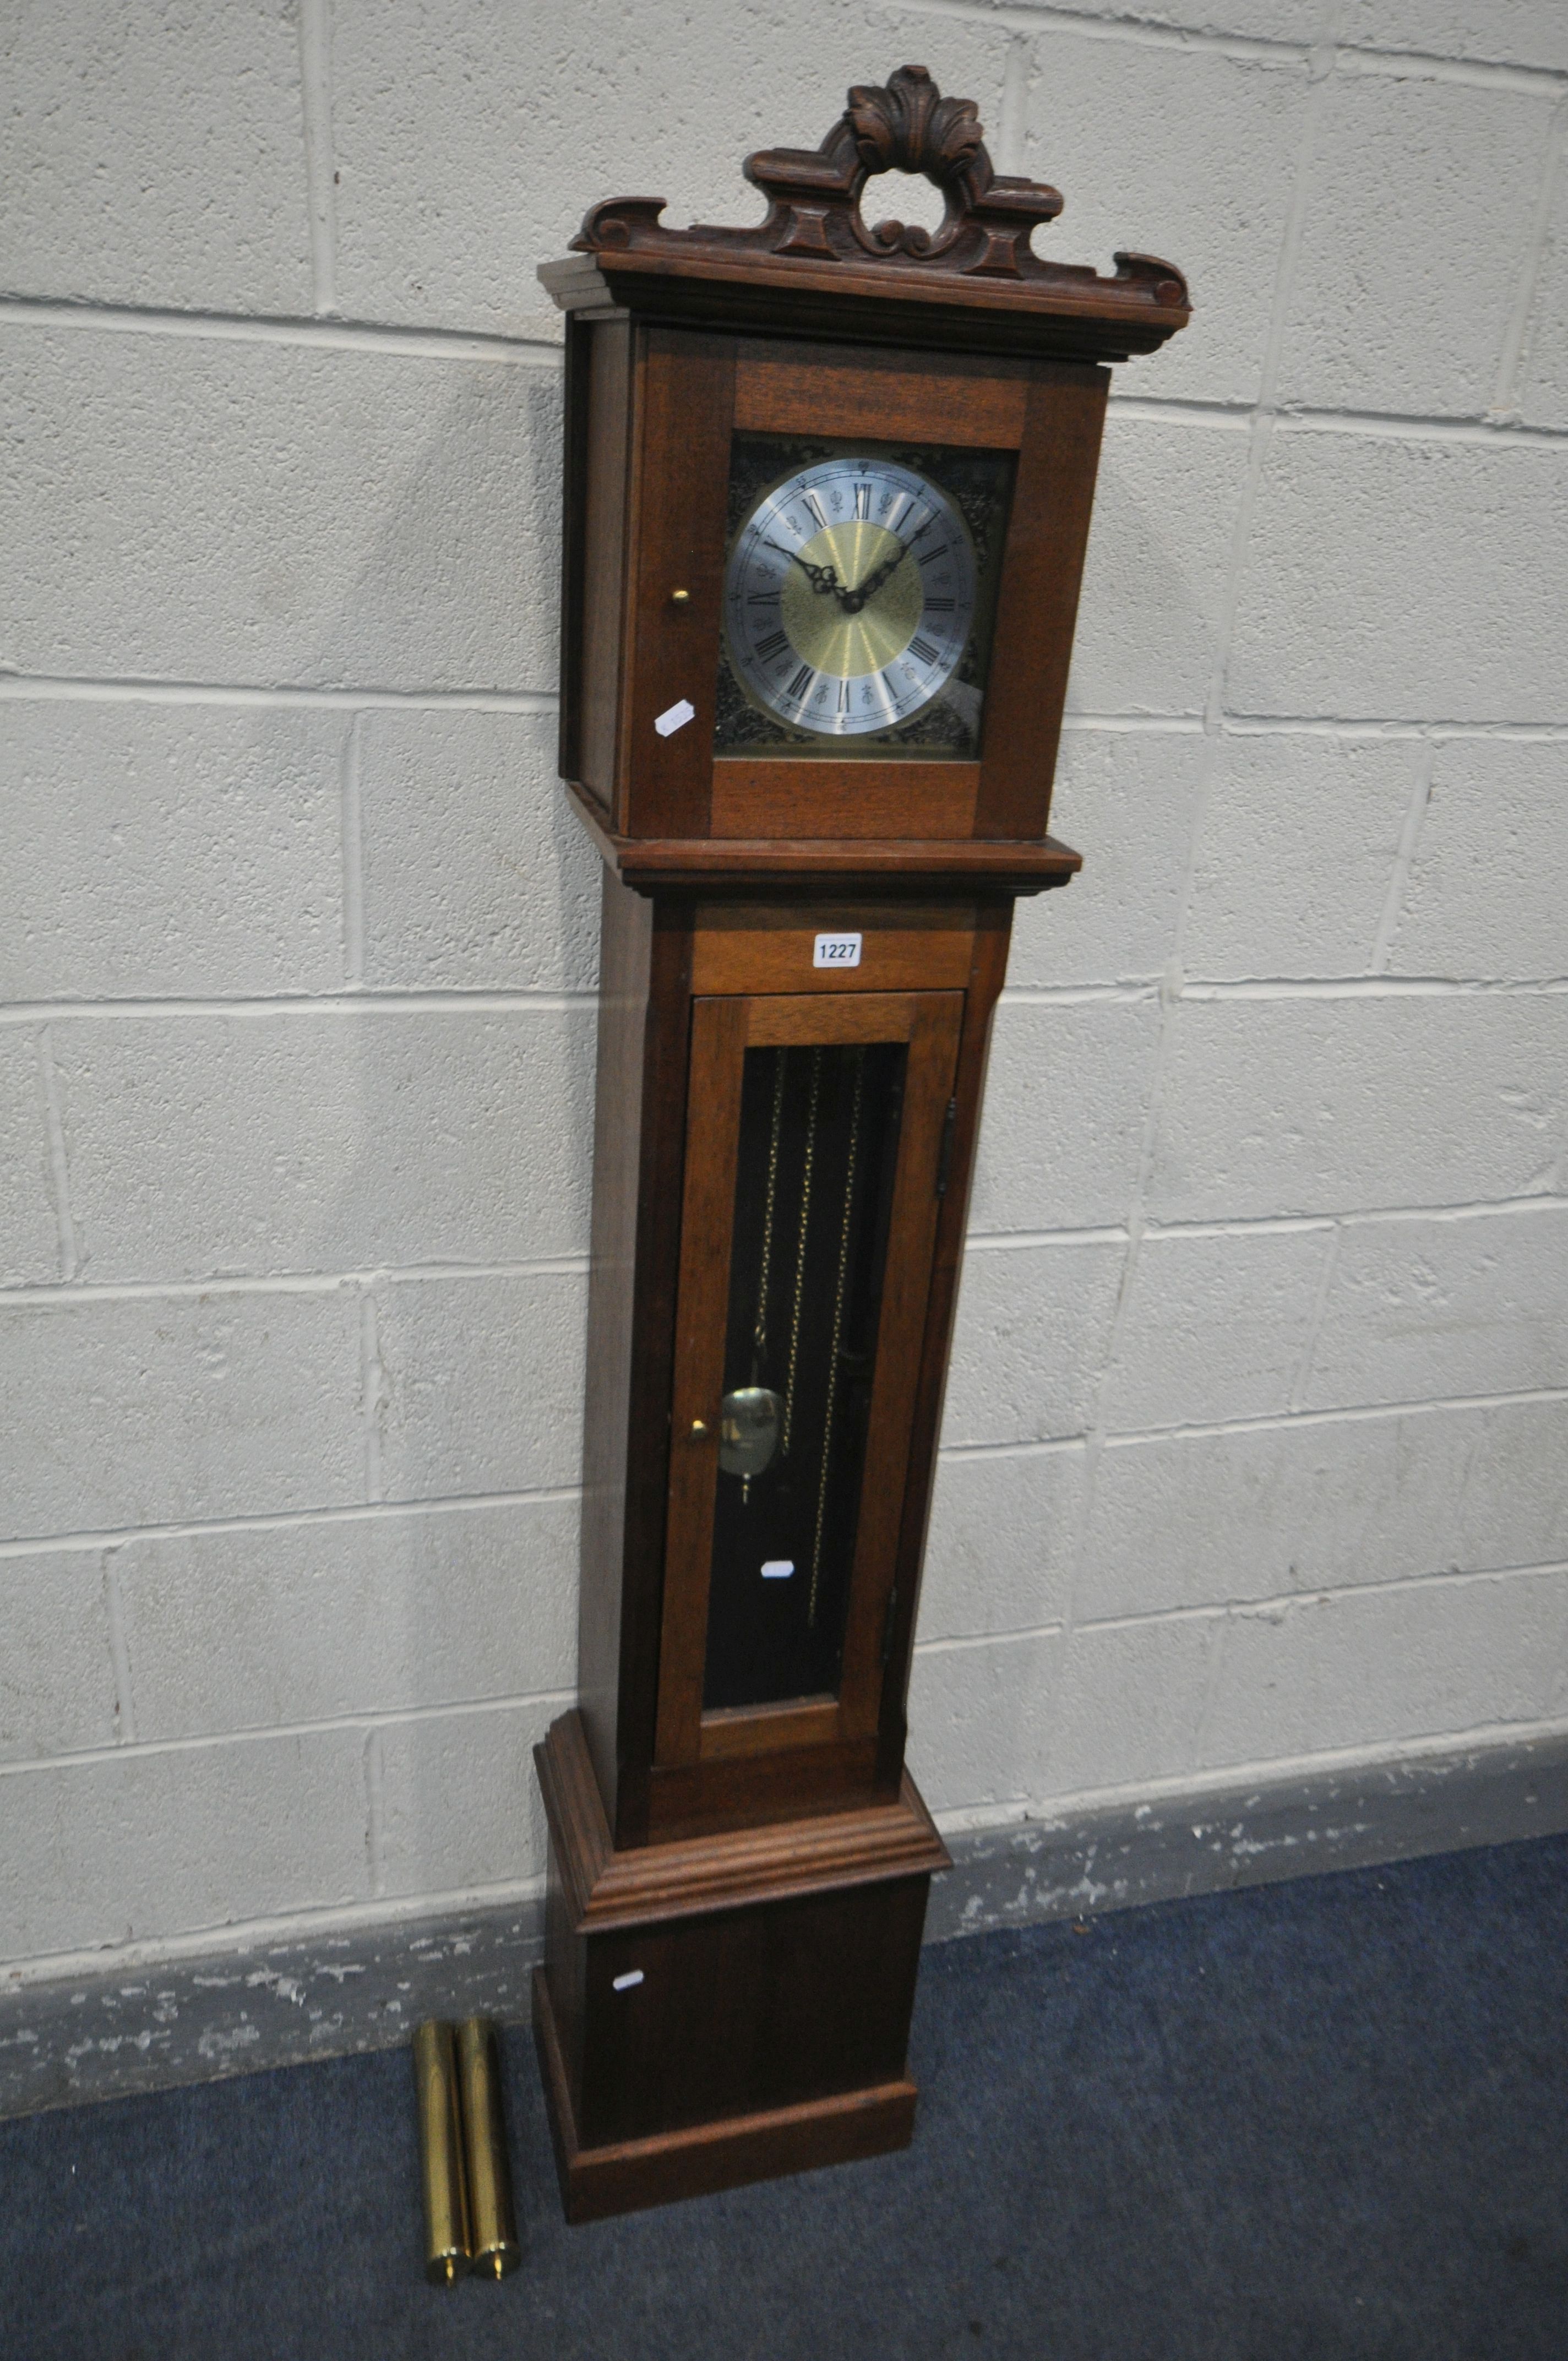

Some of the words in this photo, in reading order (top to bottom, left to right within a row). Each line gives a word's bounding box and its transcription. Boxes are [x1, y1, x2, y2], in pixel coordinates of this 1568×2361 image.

[802, 494, 828, 533] XI
[851, 482, 872, 520] XII
[918, 543, 949, 567] II
[924, 597, 955, 612] III
[754, 630, 788, 665] VIII
[820, 944, 856, 958] 1227
